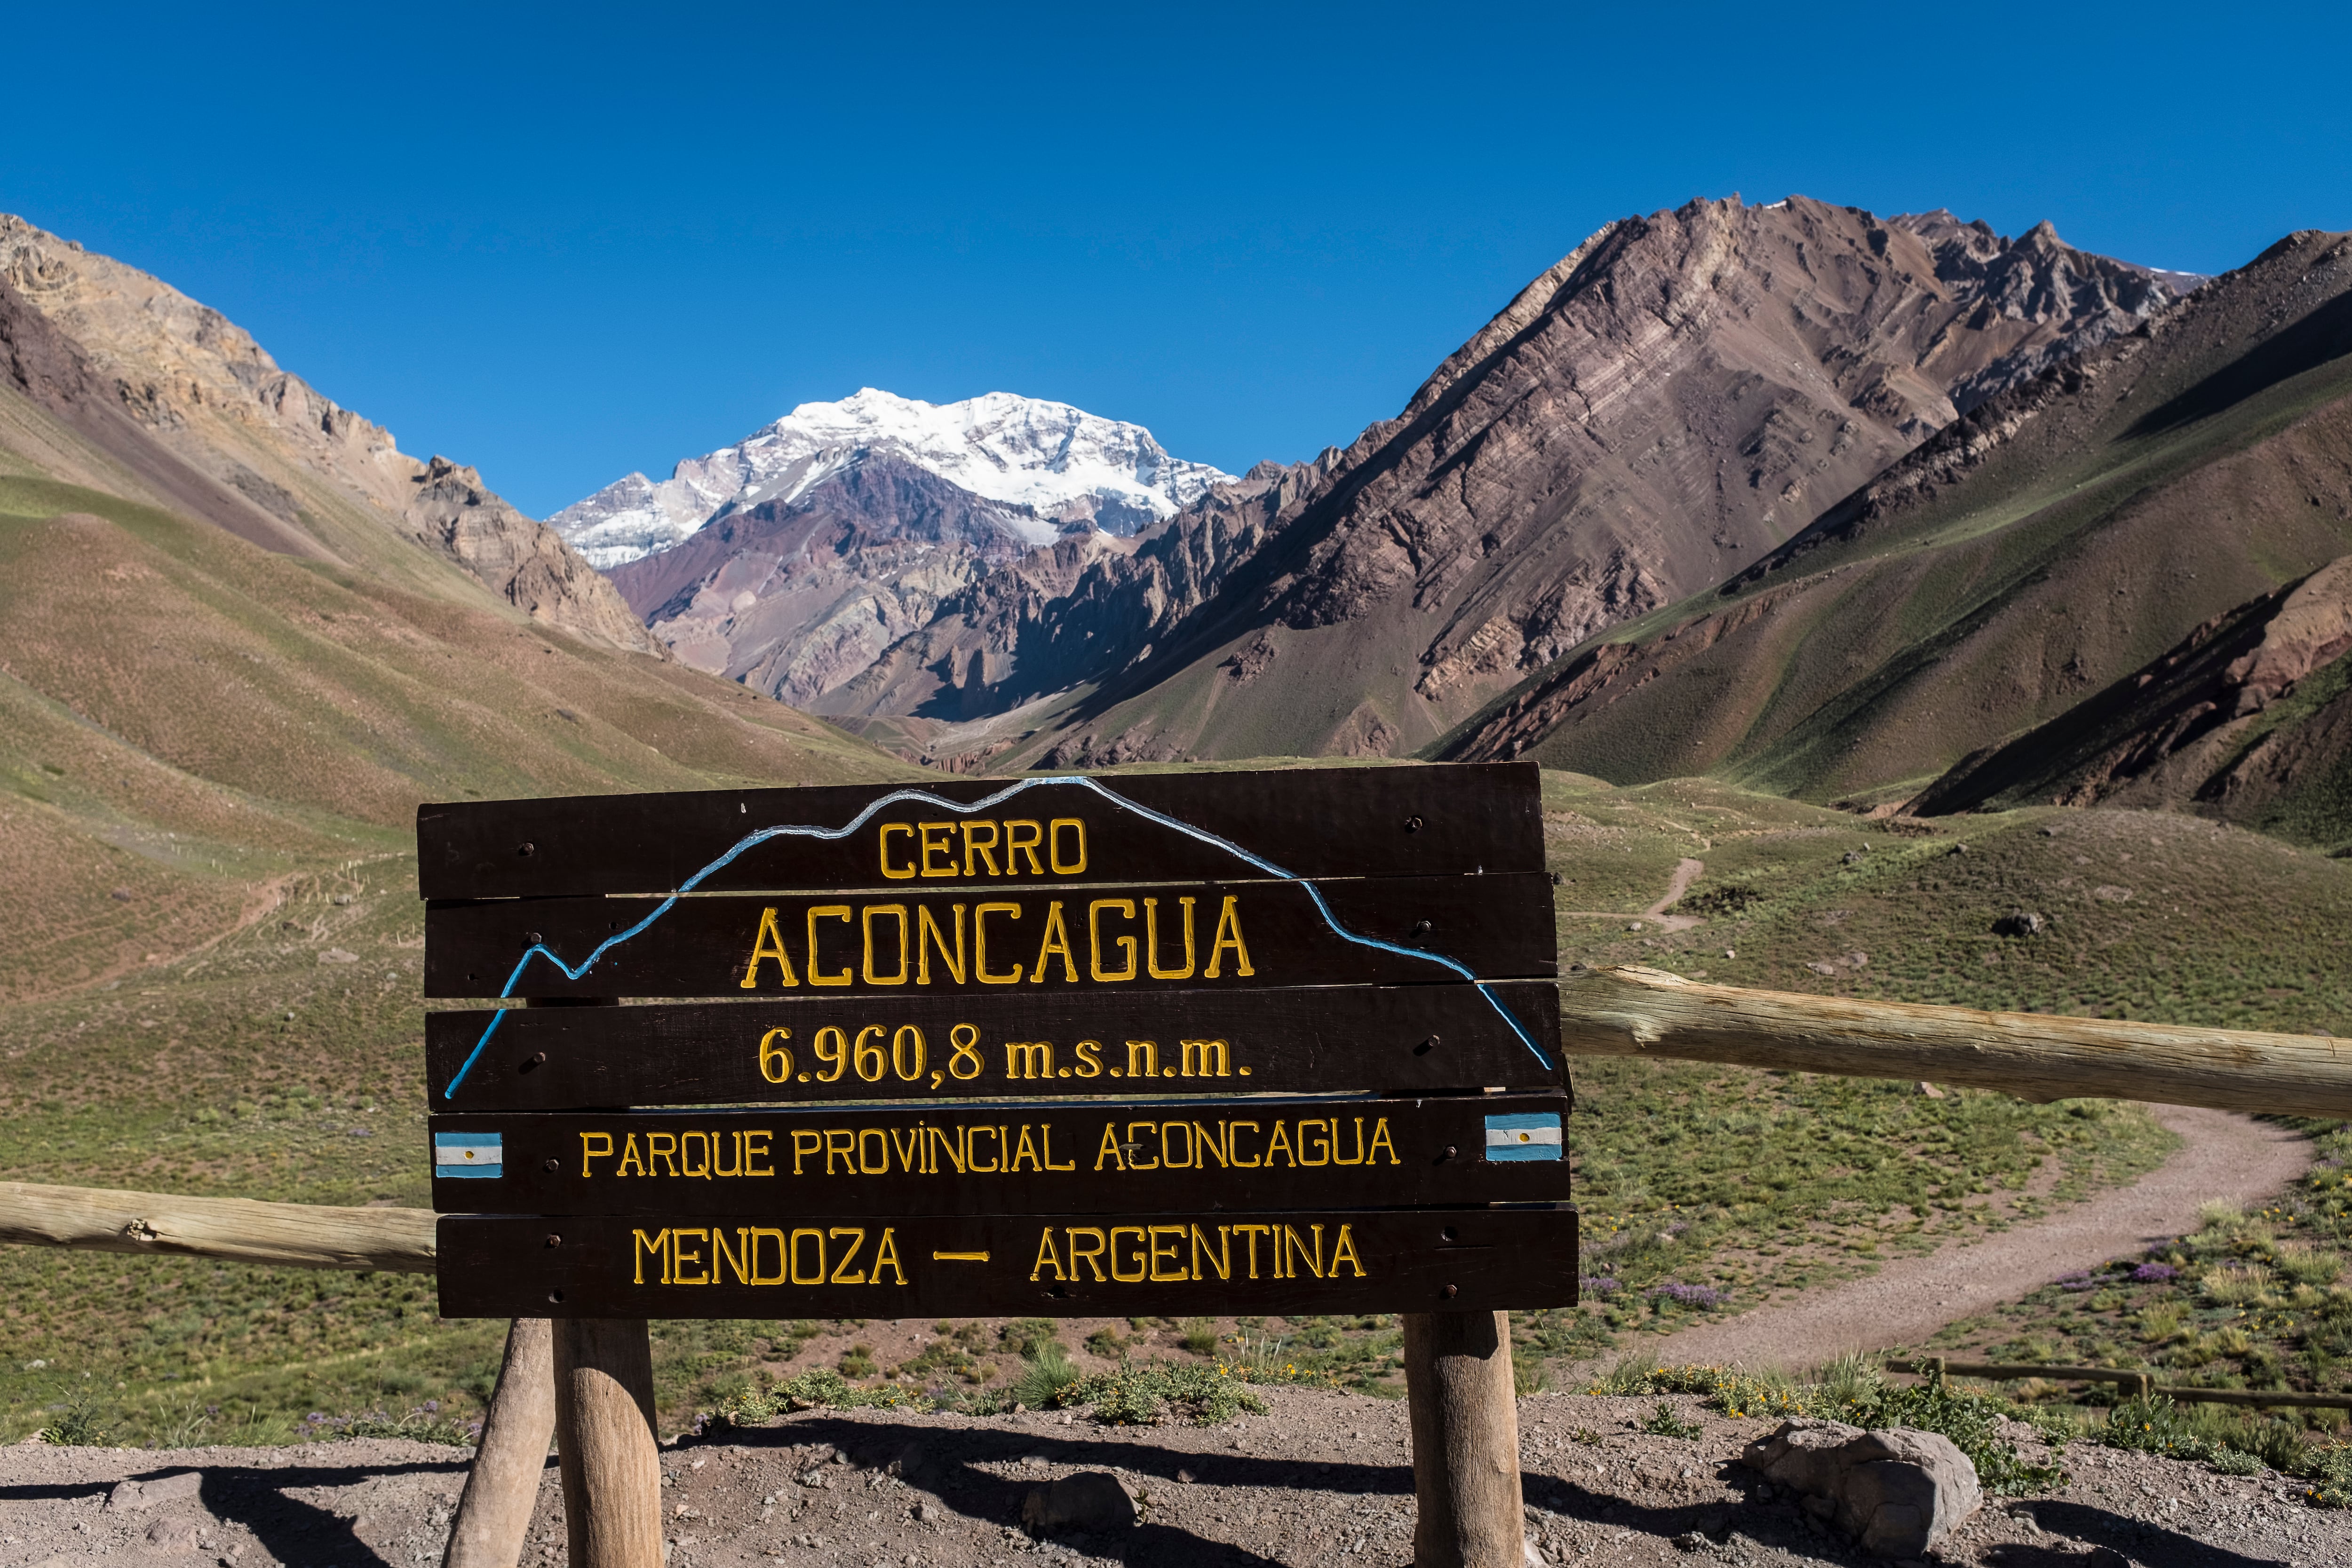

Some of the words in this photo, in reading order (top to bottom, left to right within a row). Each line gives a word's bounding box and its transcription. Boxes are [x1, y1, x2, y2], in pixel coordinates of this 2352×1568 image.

[879, 818, 1087, 879] CERRO
[739, 895, 1255, 989] ACONCAGUA
[759, 1023, 985, 1091] 6.960,8
[1006, 1038, 1253, 1080] m.s.n.m.
[579, 1130, 775, 1180] PARQUE
[1094, 1117, 1401, 1172] ACONCAGUA
[632, 1226, 908, 1286] MENDOZA
[1030, 1223, 1367, 1283] ARGENTINA
